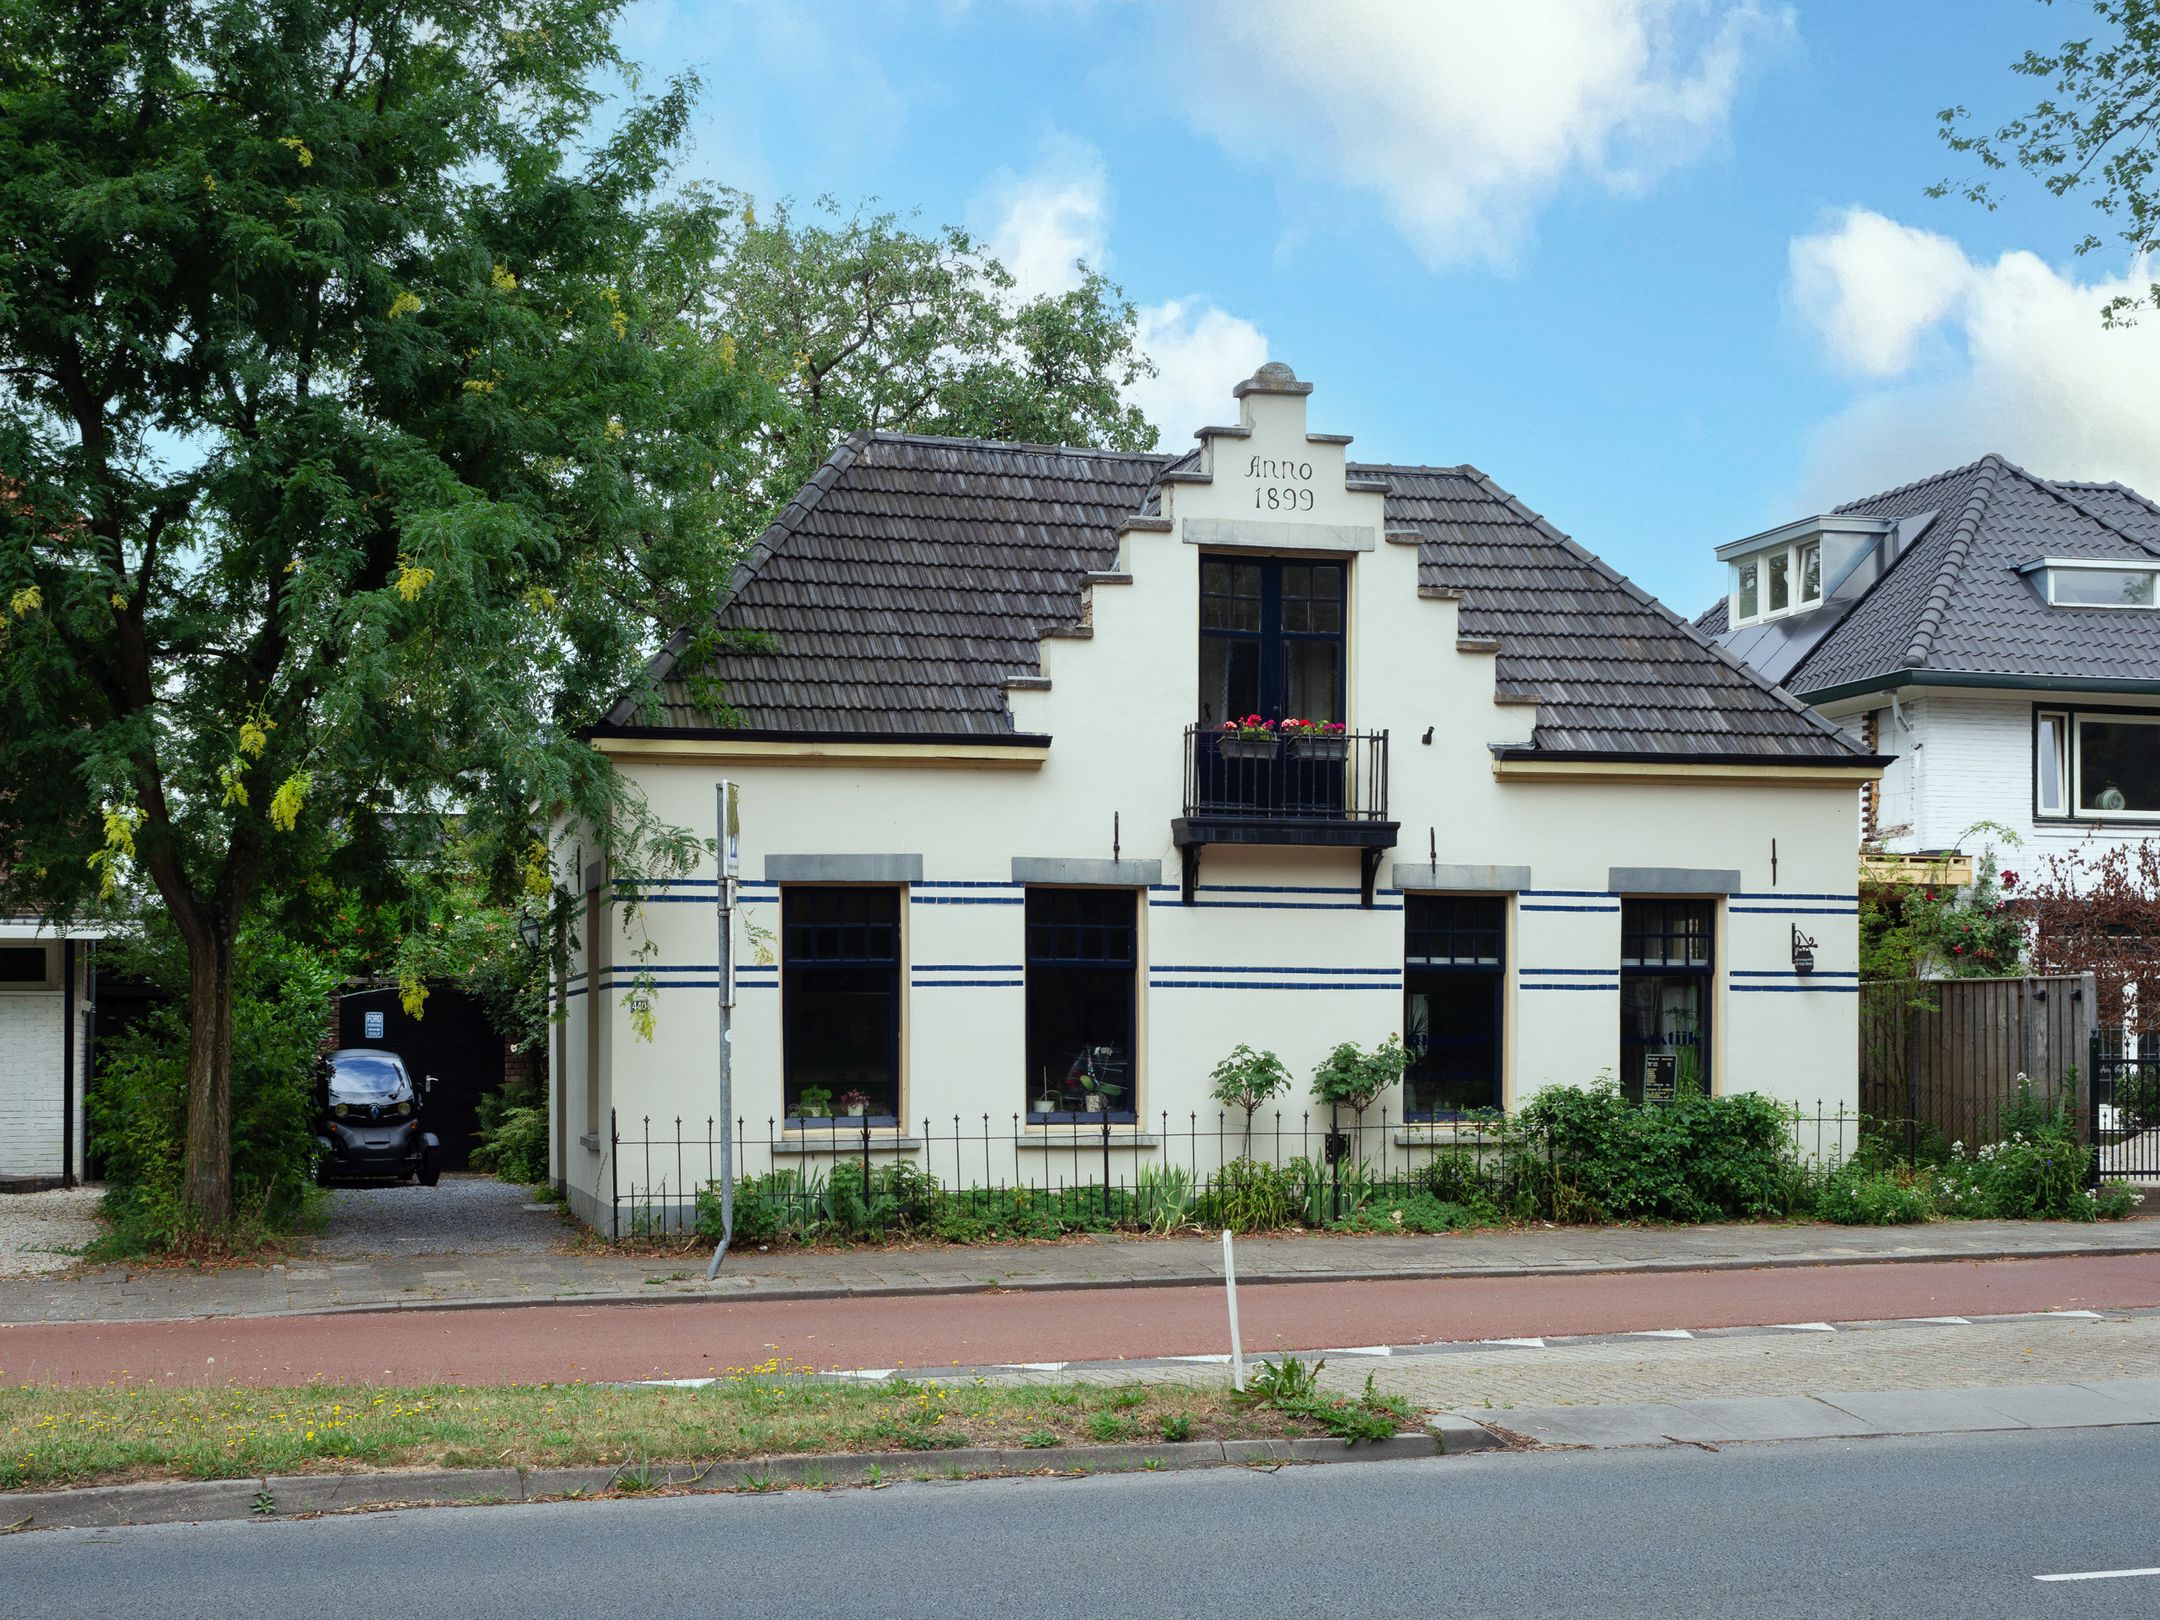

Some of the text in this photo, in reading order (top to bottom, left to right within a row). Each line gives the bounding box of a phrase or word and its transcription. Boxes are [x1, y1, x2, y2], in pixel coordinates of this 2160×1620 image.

[1244, 454, 1313, 481] Anno
[1255, 486, 1314, 512] 1899
[631, 1001, 647, 1011] 440
